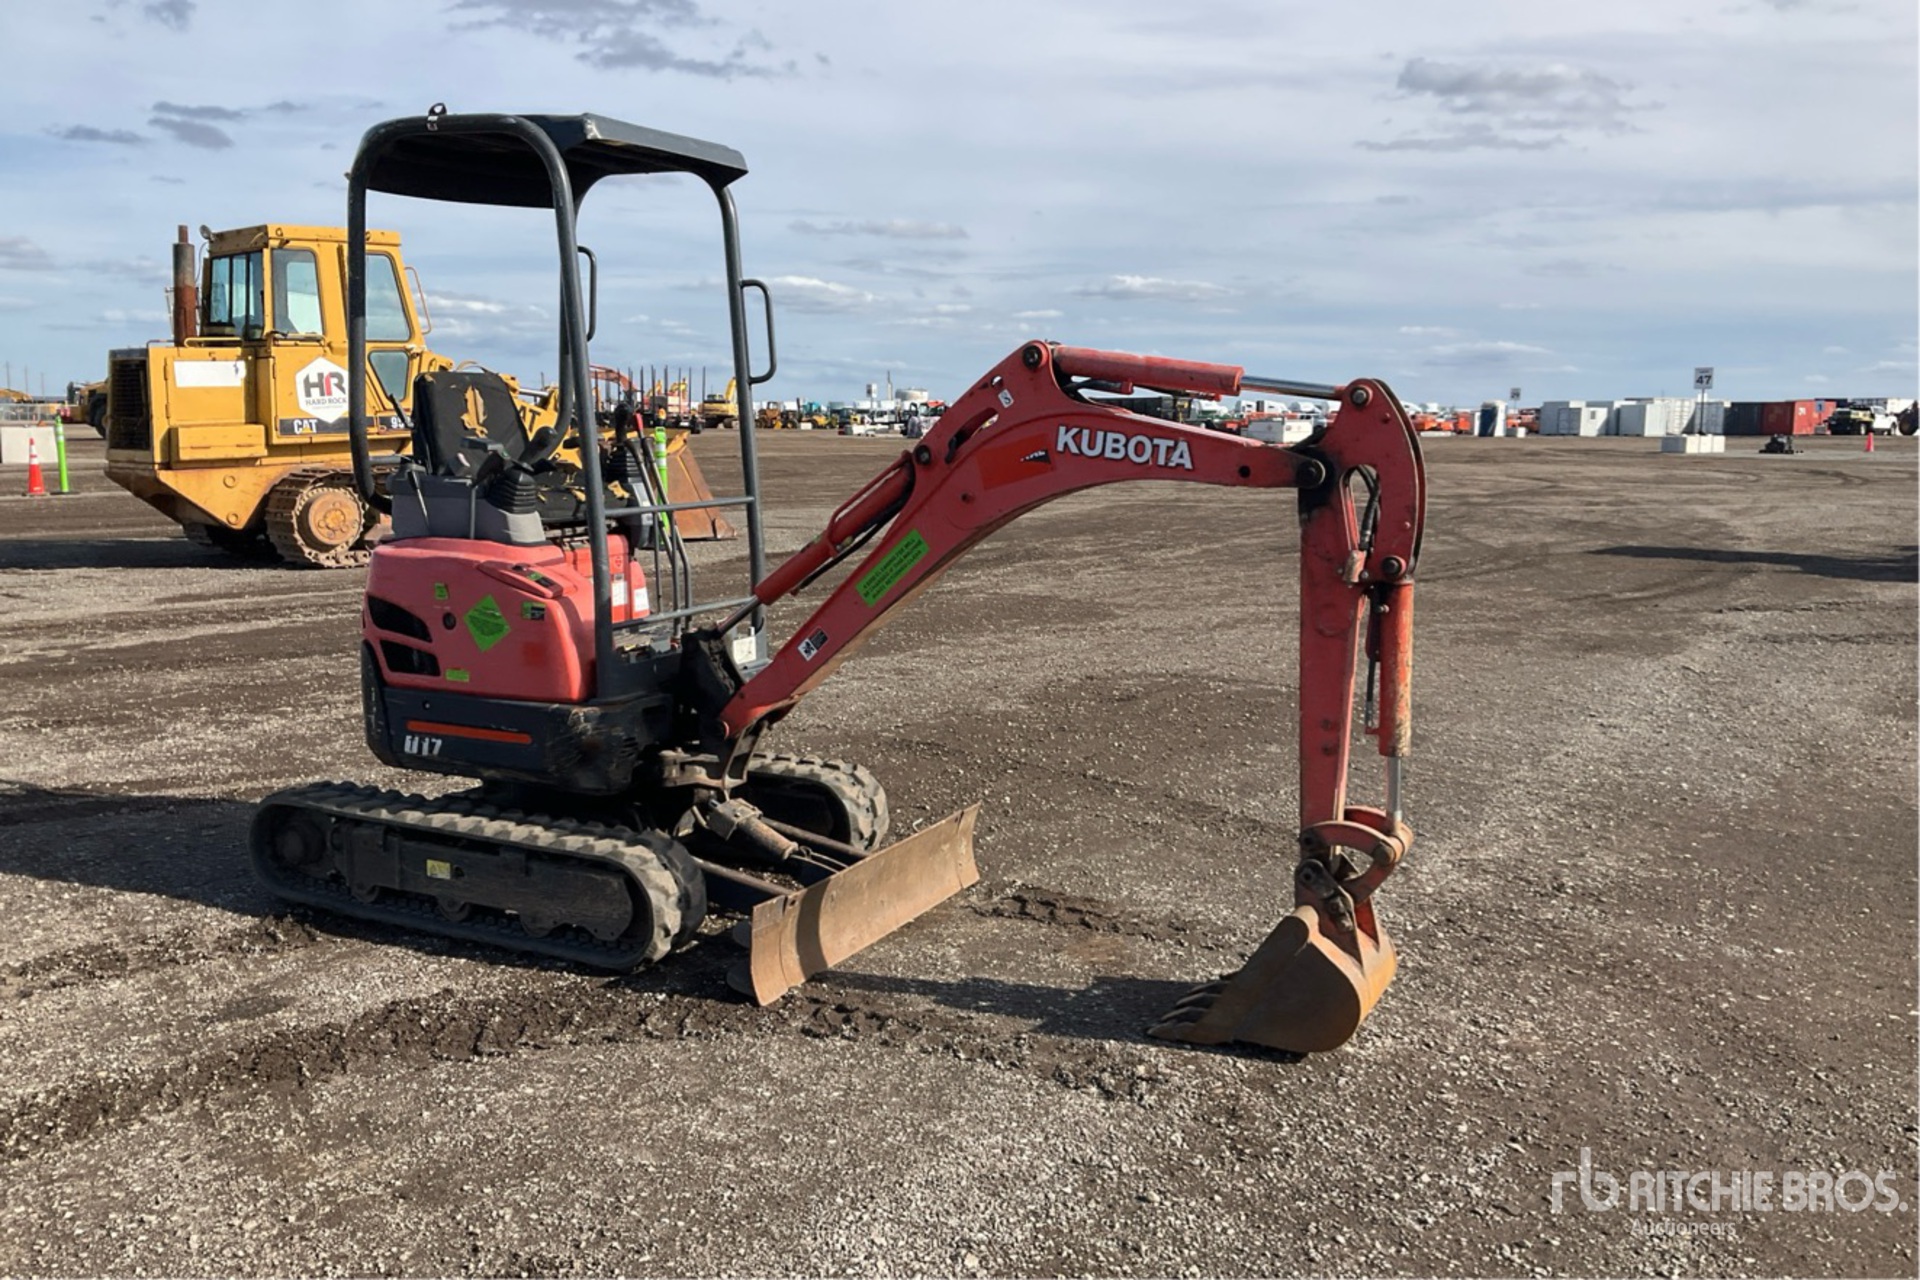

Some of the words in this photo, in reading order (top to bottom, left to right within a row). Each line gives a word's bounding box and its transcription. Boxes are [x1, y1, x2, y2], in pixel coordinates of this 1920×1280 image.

[303, 371, 346, 398] HR
[1695, 375, 1712, 385] 47
[305, 398, 327, 406] HARD
[293, 419, 319, 435] CAT
[1055, 424, 1194, 471] KUBOTA
